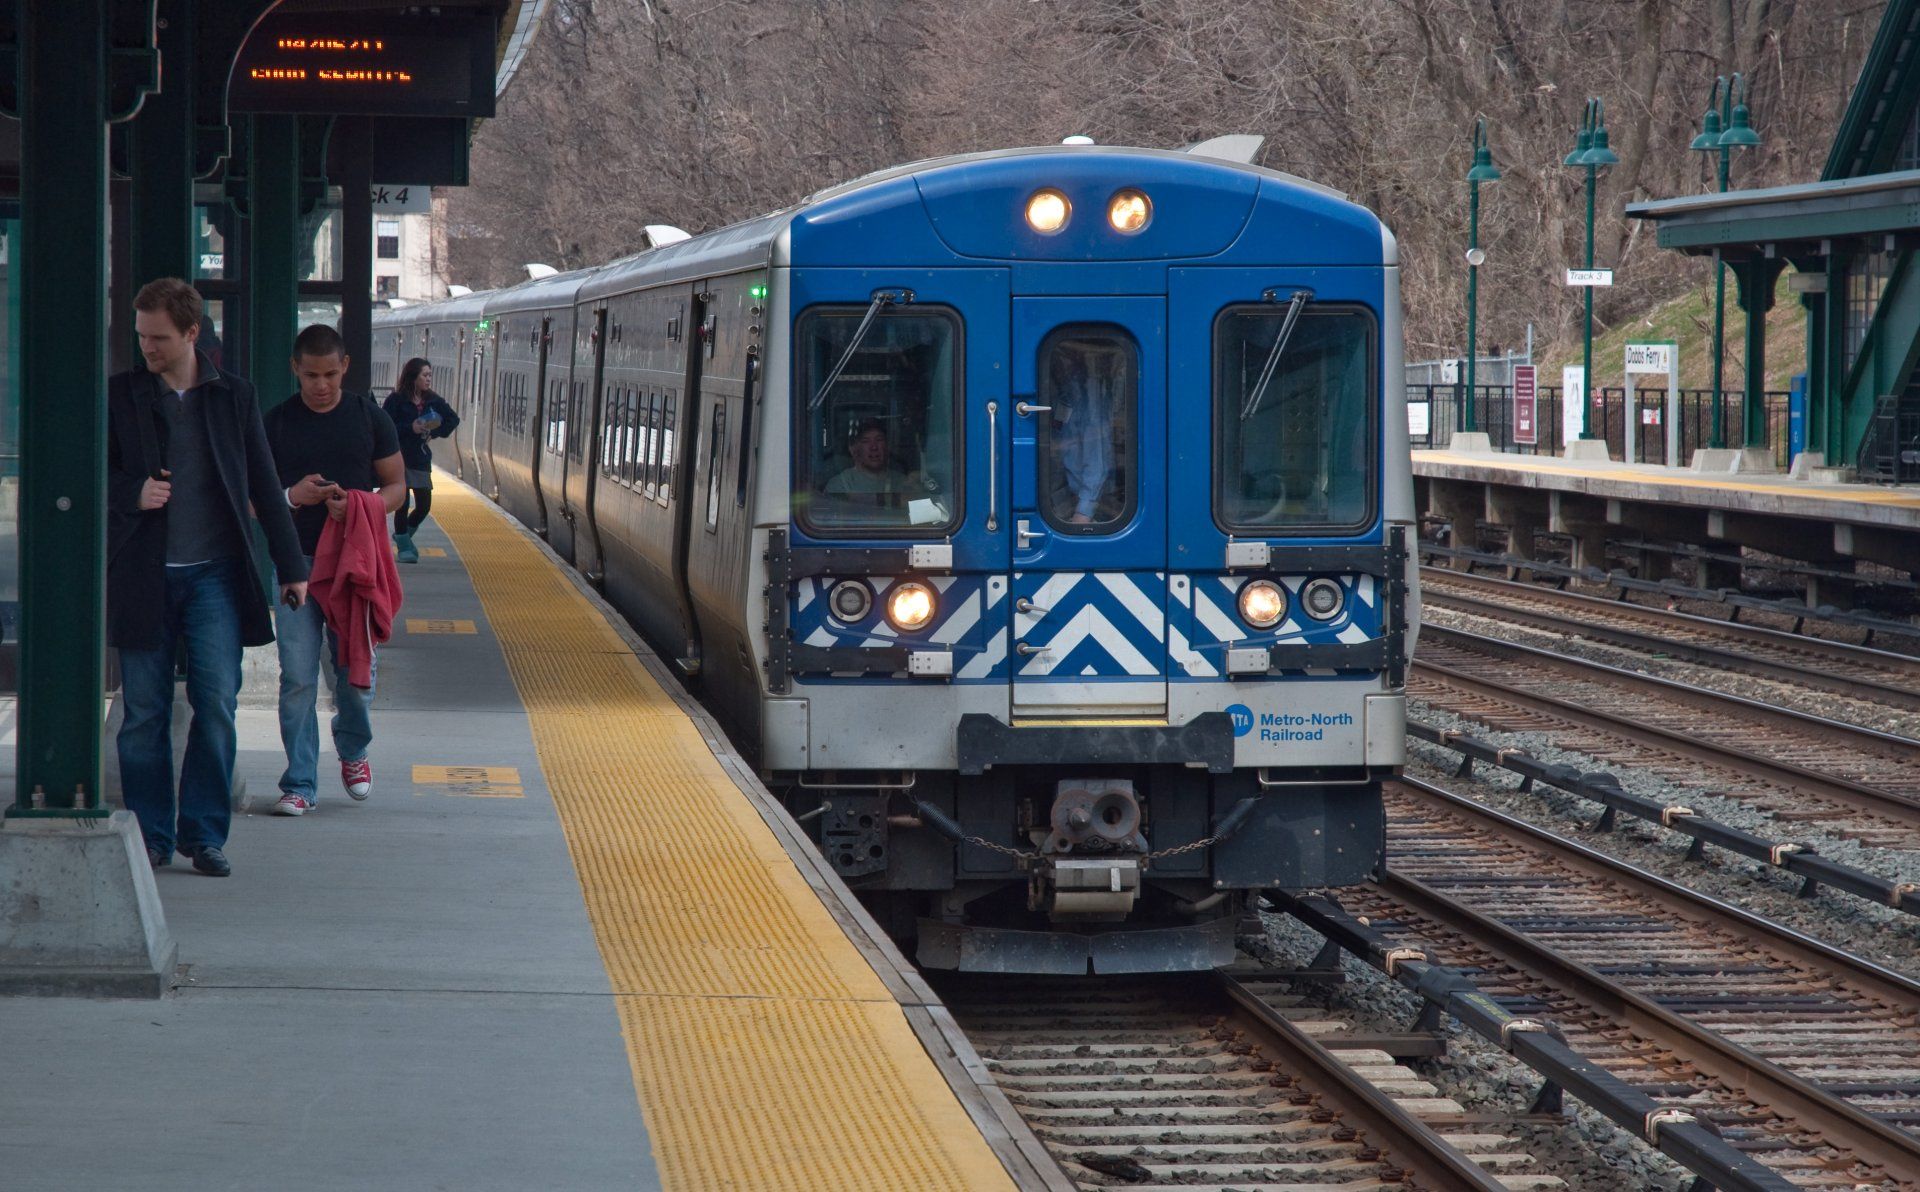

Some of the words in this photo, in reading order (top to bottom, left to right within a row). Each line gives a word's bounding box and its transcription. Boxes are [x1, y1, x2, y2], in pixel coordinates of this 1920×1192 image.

[372, 187, 390, 204] ck
[395, 187, 409, 205] 4
[1570, 271, 1594, 280] Track
[1597, 272, 1603, 280] 3
[1628, 347, 1644, 364] Dobbs
[1646, 347, 1660, 368] Ferry
[1260, 713, 1353, 726] Metro-North
[1260, 729, 1323, 741] Railroad
